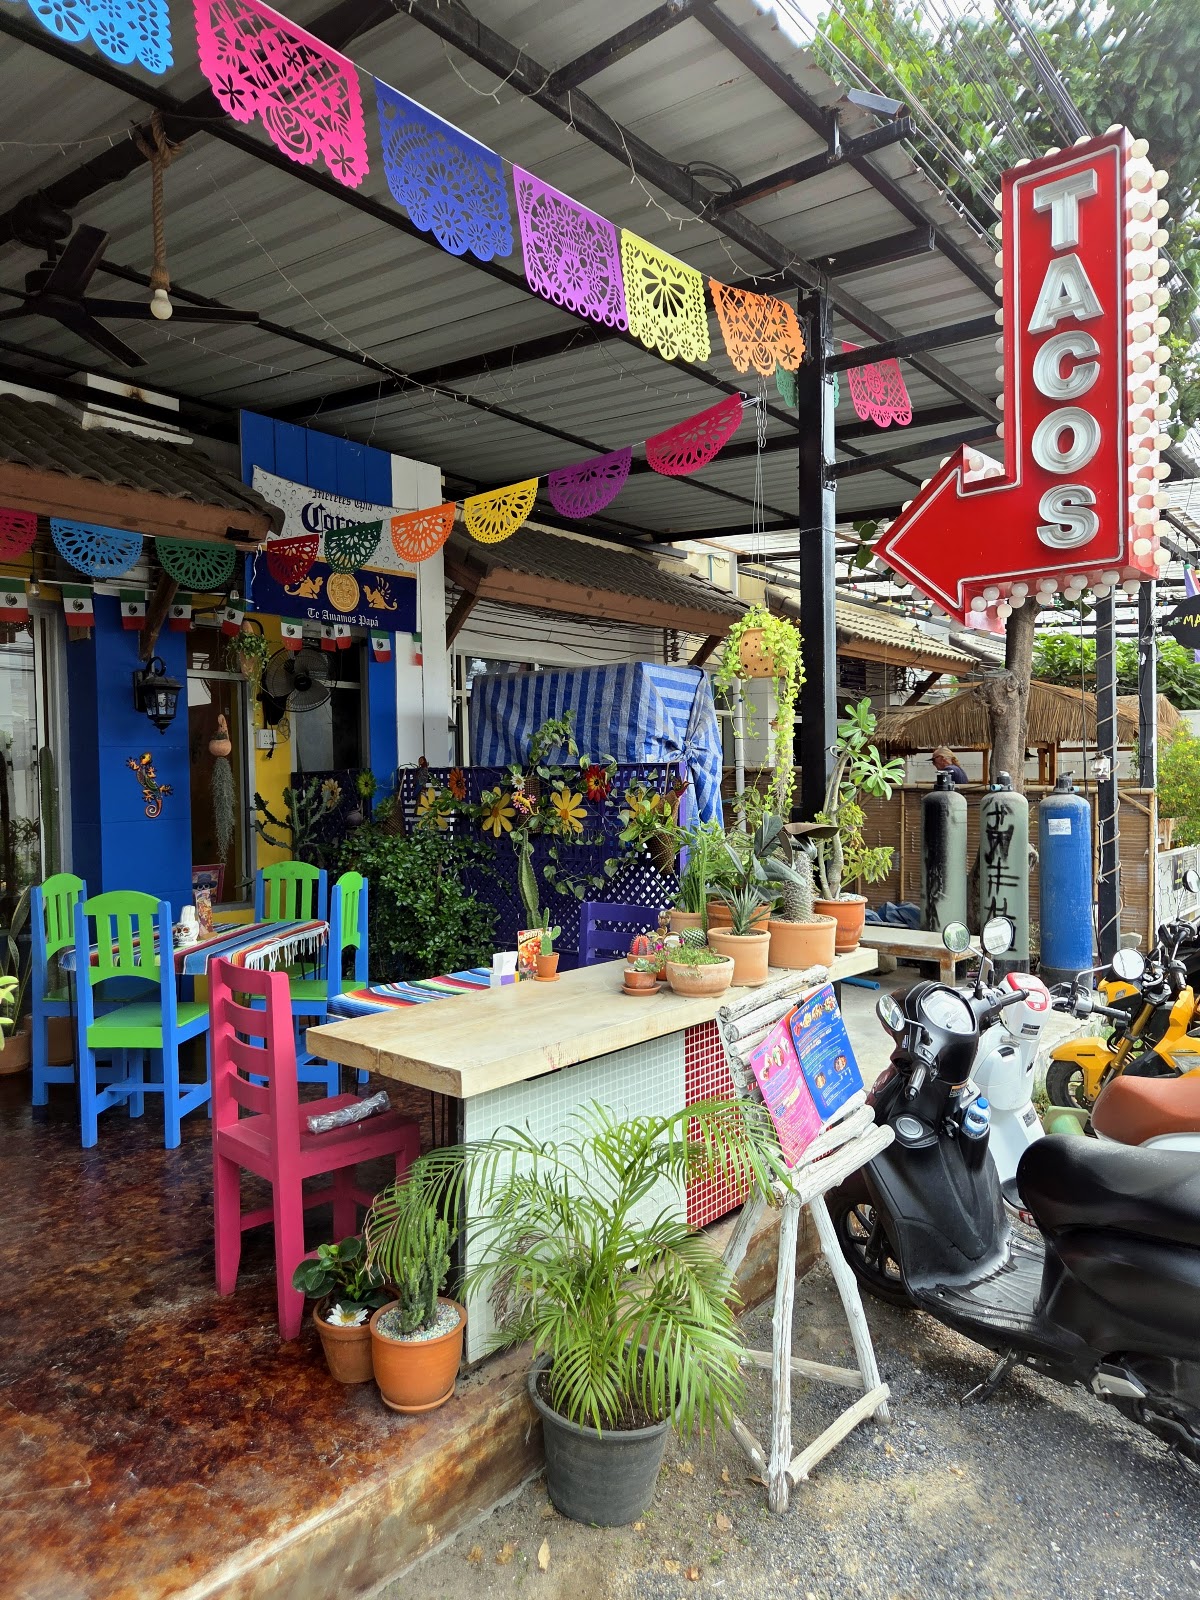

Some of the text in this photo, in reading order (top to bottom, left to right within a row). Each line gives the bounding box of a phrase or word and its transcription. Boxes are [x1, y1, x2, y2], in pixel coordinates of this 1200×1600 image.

[1028, 167, 1105, 550] TACOS
[307, 607, 320, 619] Te
[321, 609, 357, 624] Amamos
